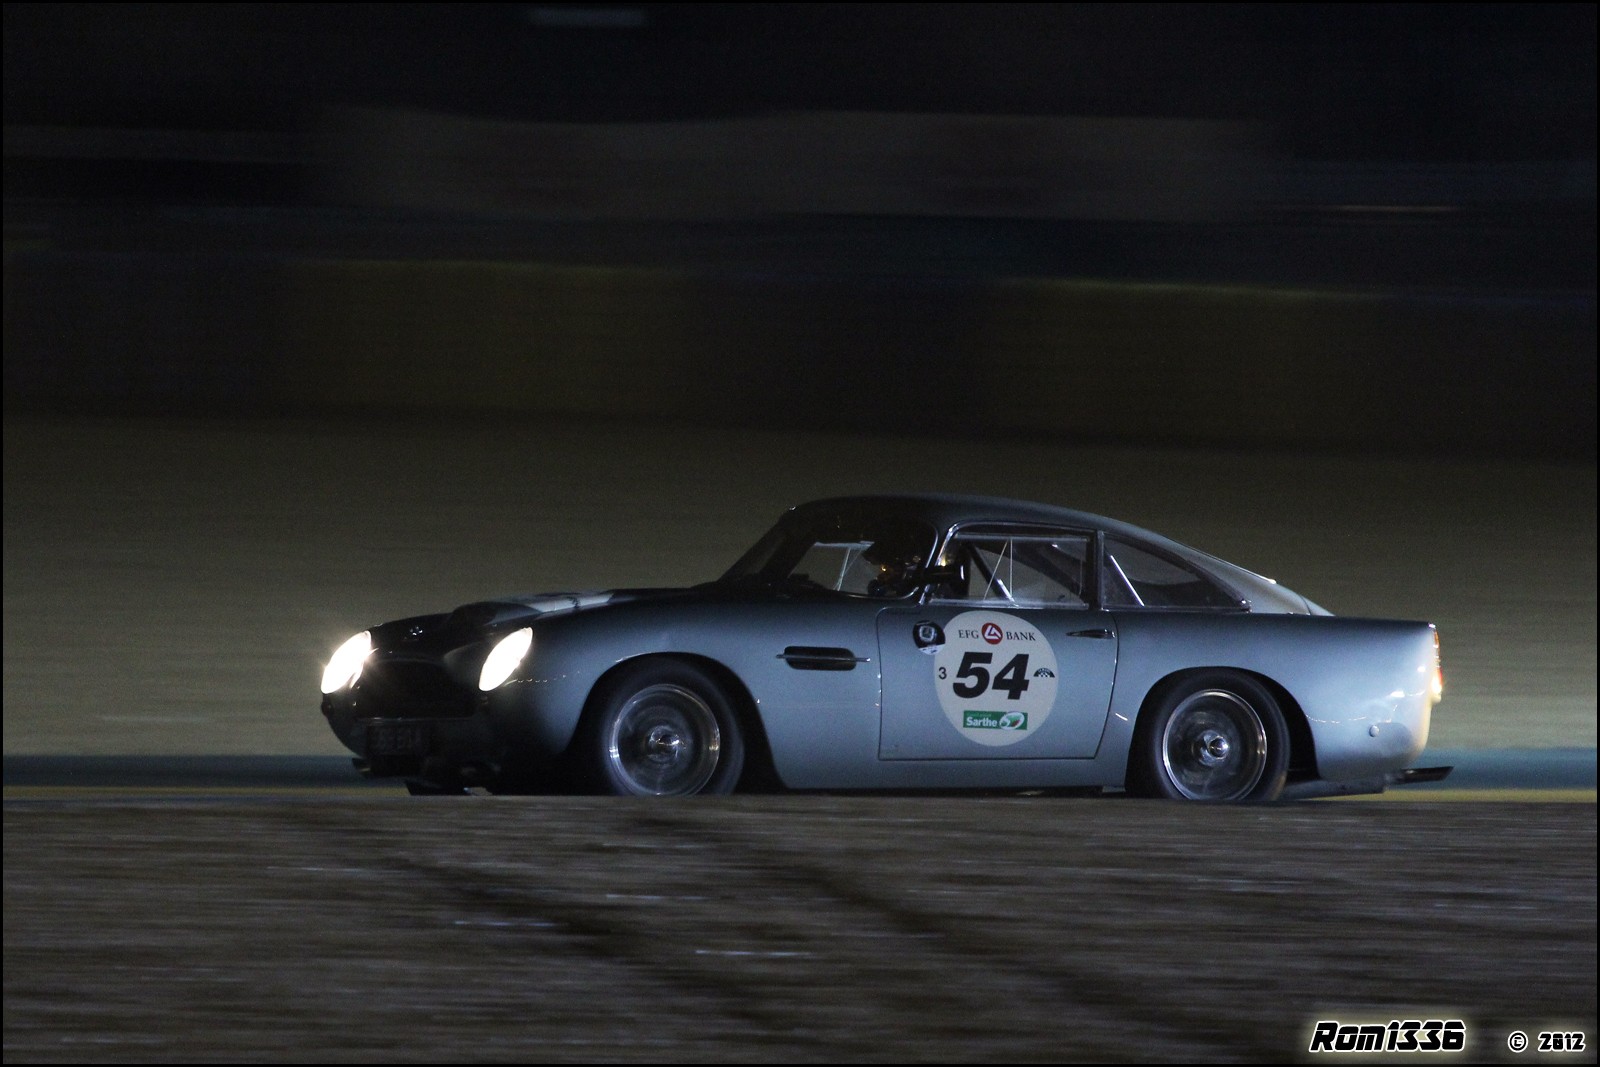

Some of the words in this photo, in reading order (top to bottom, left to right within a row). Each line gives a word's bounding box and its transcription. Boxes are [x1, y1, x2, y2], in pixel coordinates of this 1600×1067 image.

[958, 629, 979, 640] EFG
[1006, 631, 1036, 642] BANK
[938, 667, 947, 680] 3
[952, 651, 1030, 701] 54
[966, 716, 998, 727] Sarthe
